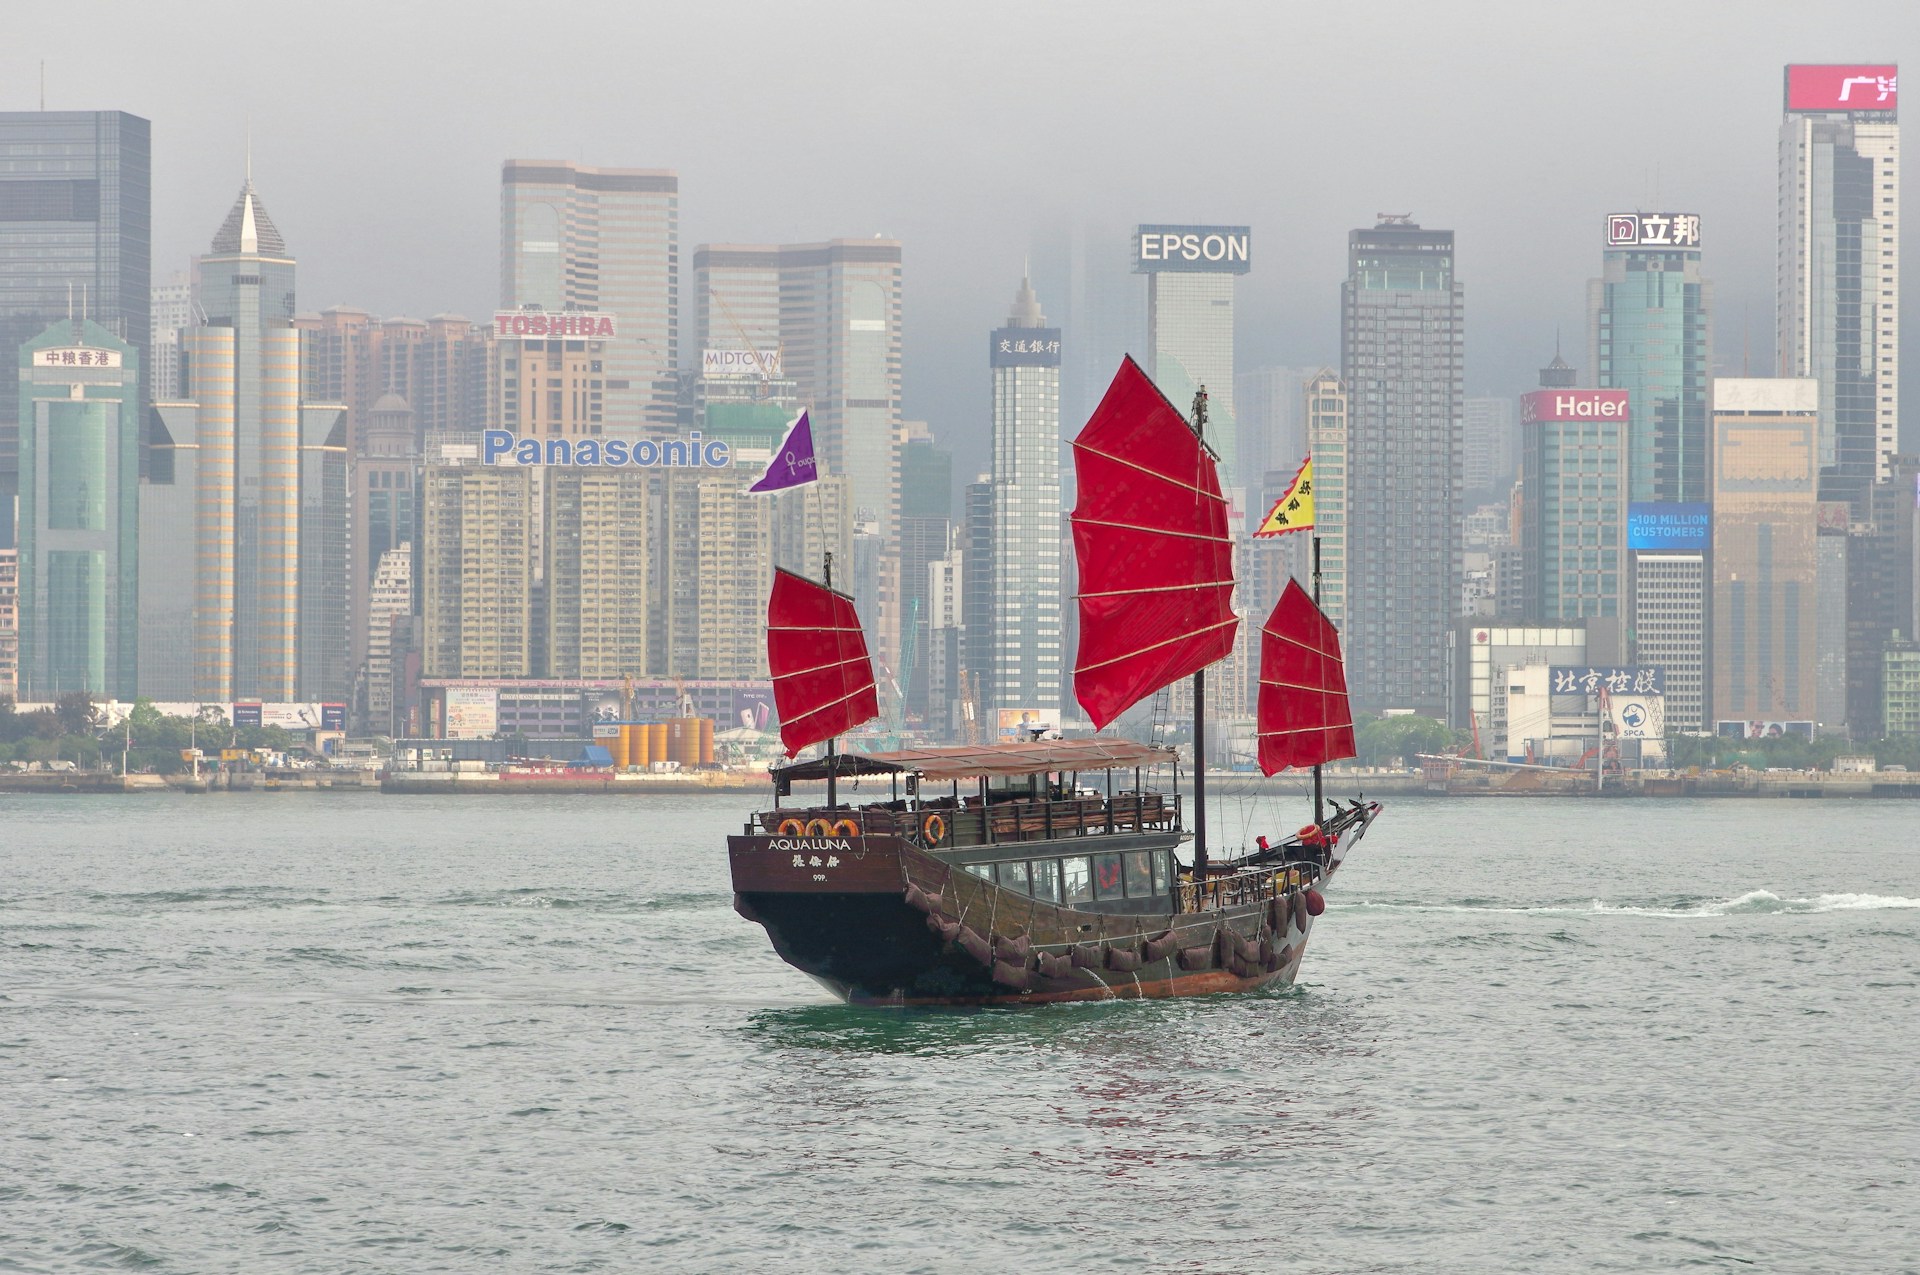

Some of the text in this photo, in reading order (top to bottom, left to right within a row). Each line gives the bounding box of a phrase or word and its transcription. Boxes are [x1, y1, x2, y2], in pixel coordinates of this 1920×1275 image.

[1641, 214, 1700, 245] 立邦
[1141, 233, 1248, 261] EPSON
[495, 315, 616, 337] TOSHIBA
[1000, 339, 1060, 354] 交通銀行
[46, 351, 110, 366] 中粮香港
[705, 351, 782, 366] MIDTOWN
[1556, 396, 1626, 416] Haier
[483, 429, 730, 468] Panasonic
[1660, 514, 1708, 525] MILLION
[1633, 527, 1704, 538] CUSTOMERS
[1554, 668, 1660, 694] 北京控股
